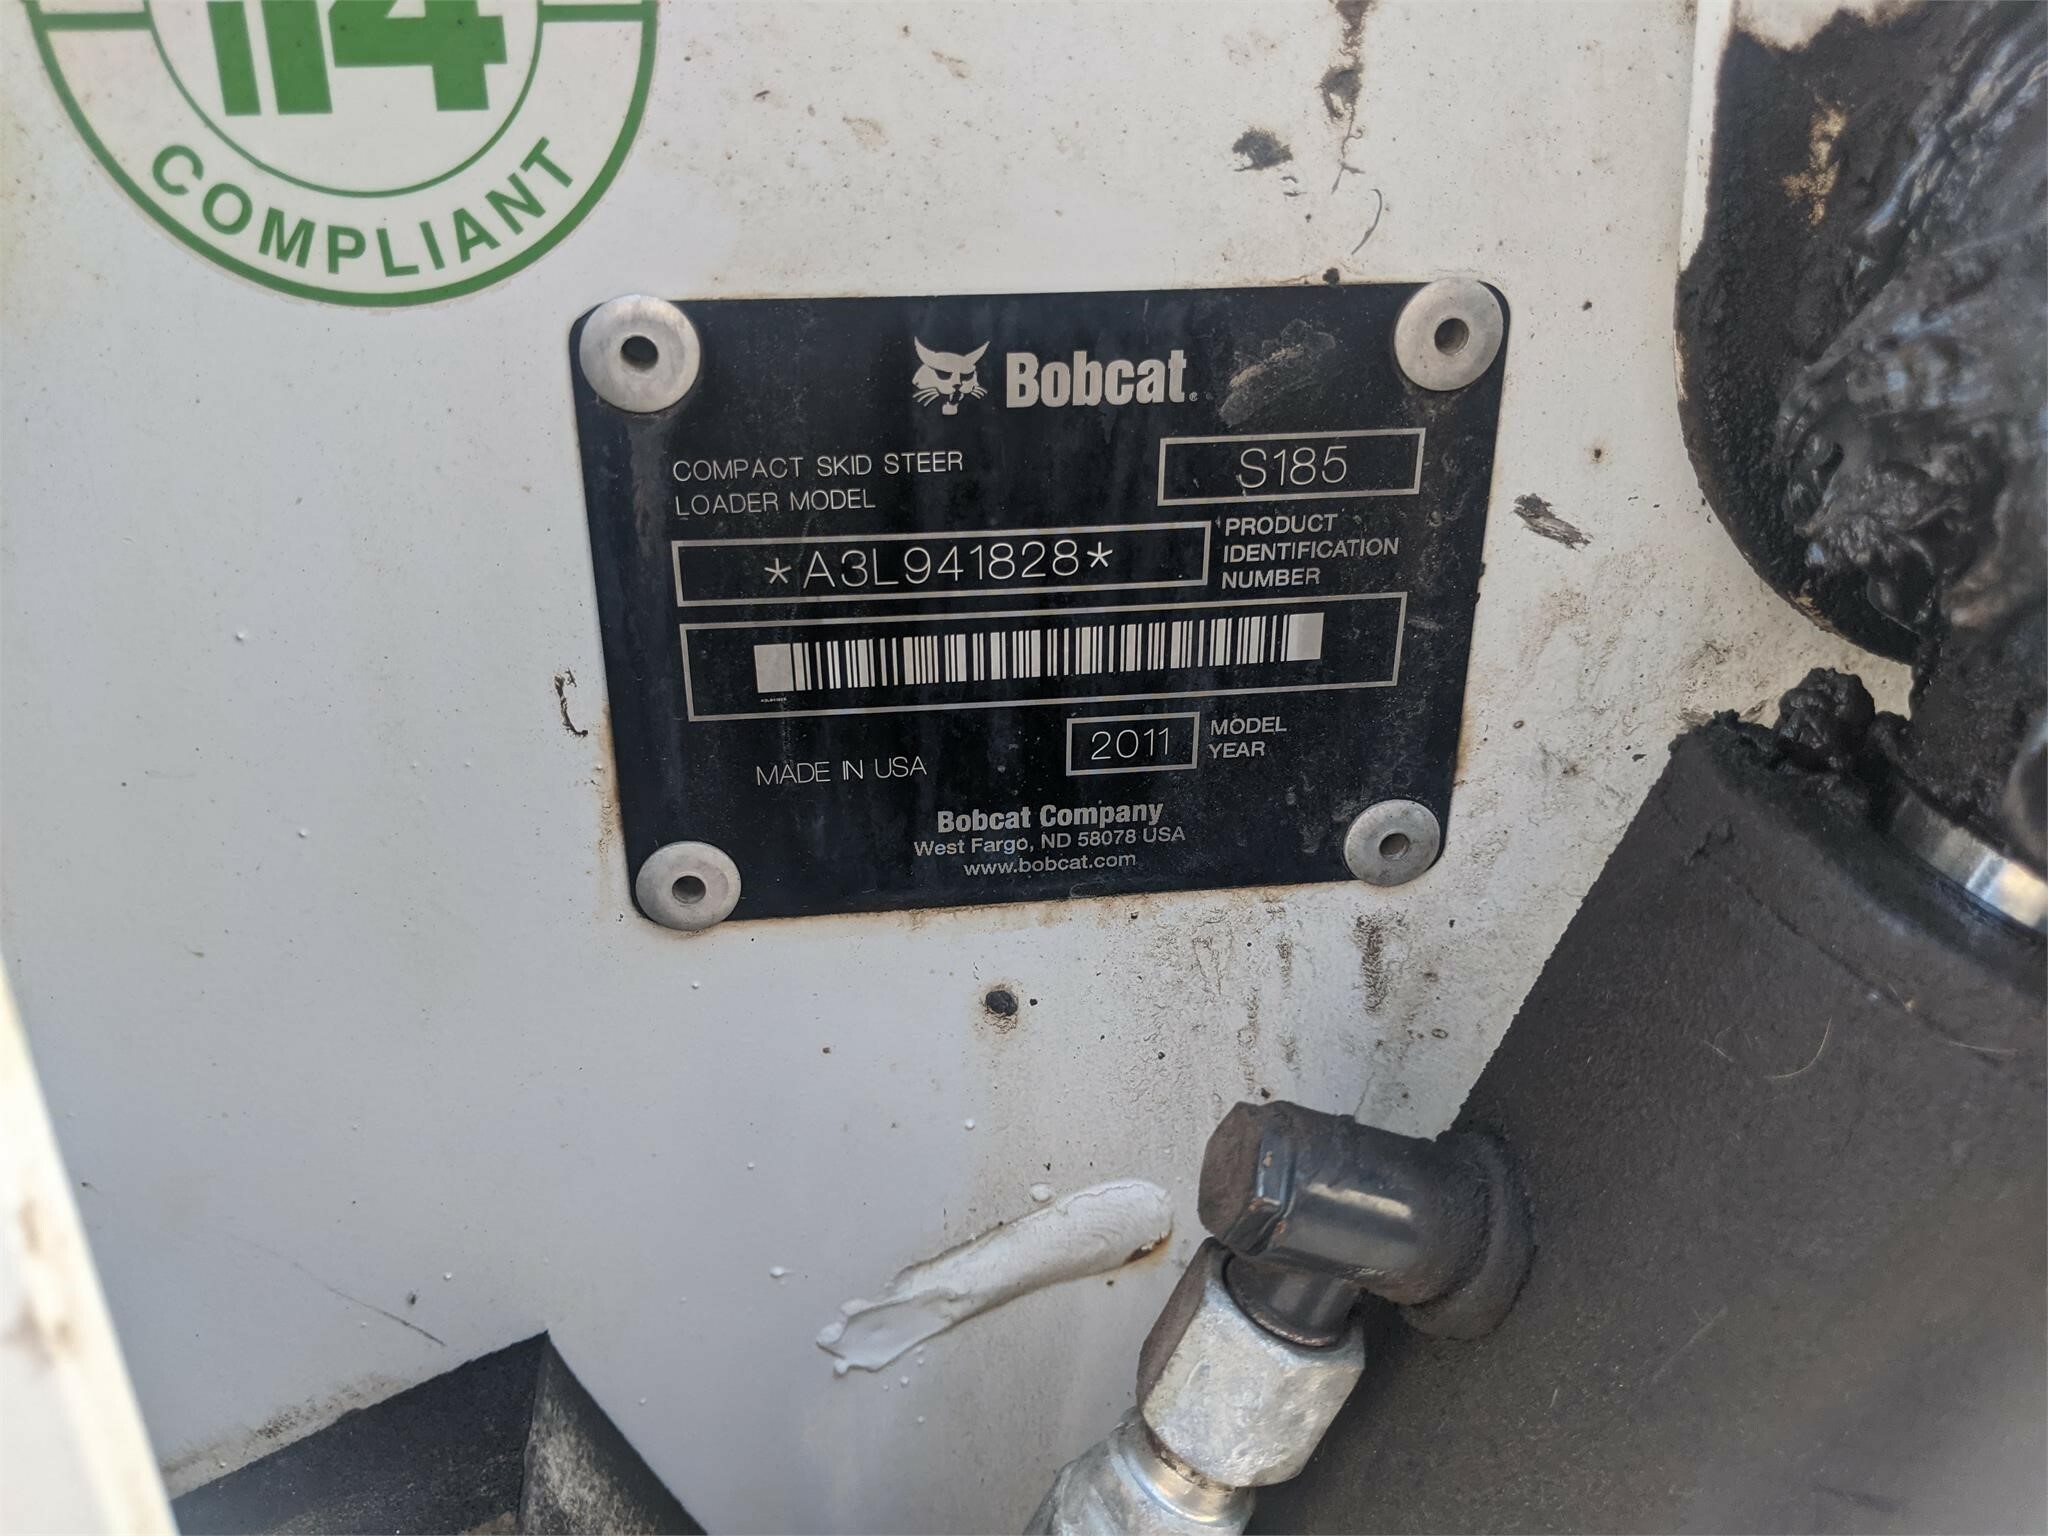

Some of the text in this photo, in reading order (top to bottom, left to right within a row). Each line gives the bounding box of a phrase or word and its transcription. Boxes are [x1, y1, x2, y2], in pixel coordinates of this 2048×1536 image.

[151, 137, 574, 277] COMPLIANT
[672, 450, 963, 482] COMPACT SKID STEER
[1238, 445, 1348, 489] S185
[675, 488, 876, 516] LOADER MODEL
[1225, 513, 1339, 537] PRODUCT
[1223, 537, 1400, 563] IDENTIFICATION
[1221, 567, 1321, 590] NUMBER
[1210, 716, 1288, 736] MODEL
[1090, 727, 1170, 761] 2011
[1208, 740, 1266, 760] YEAR
[756, 755, 928, 786] MADE IN USA
[937, 801, 1165, 834] Bobcat Company
[913, 826, 1186, 857] West Fargo, ND 58078 USA
[963, 851, 1137, 877] www.bobcat.com
